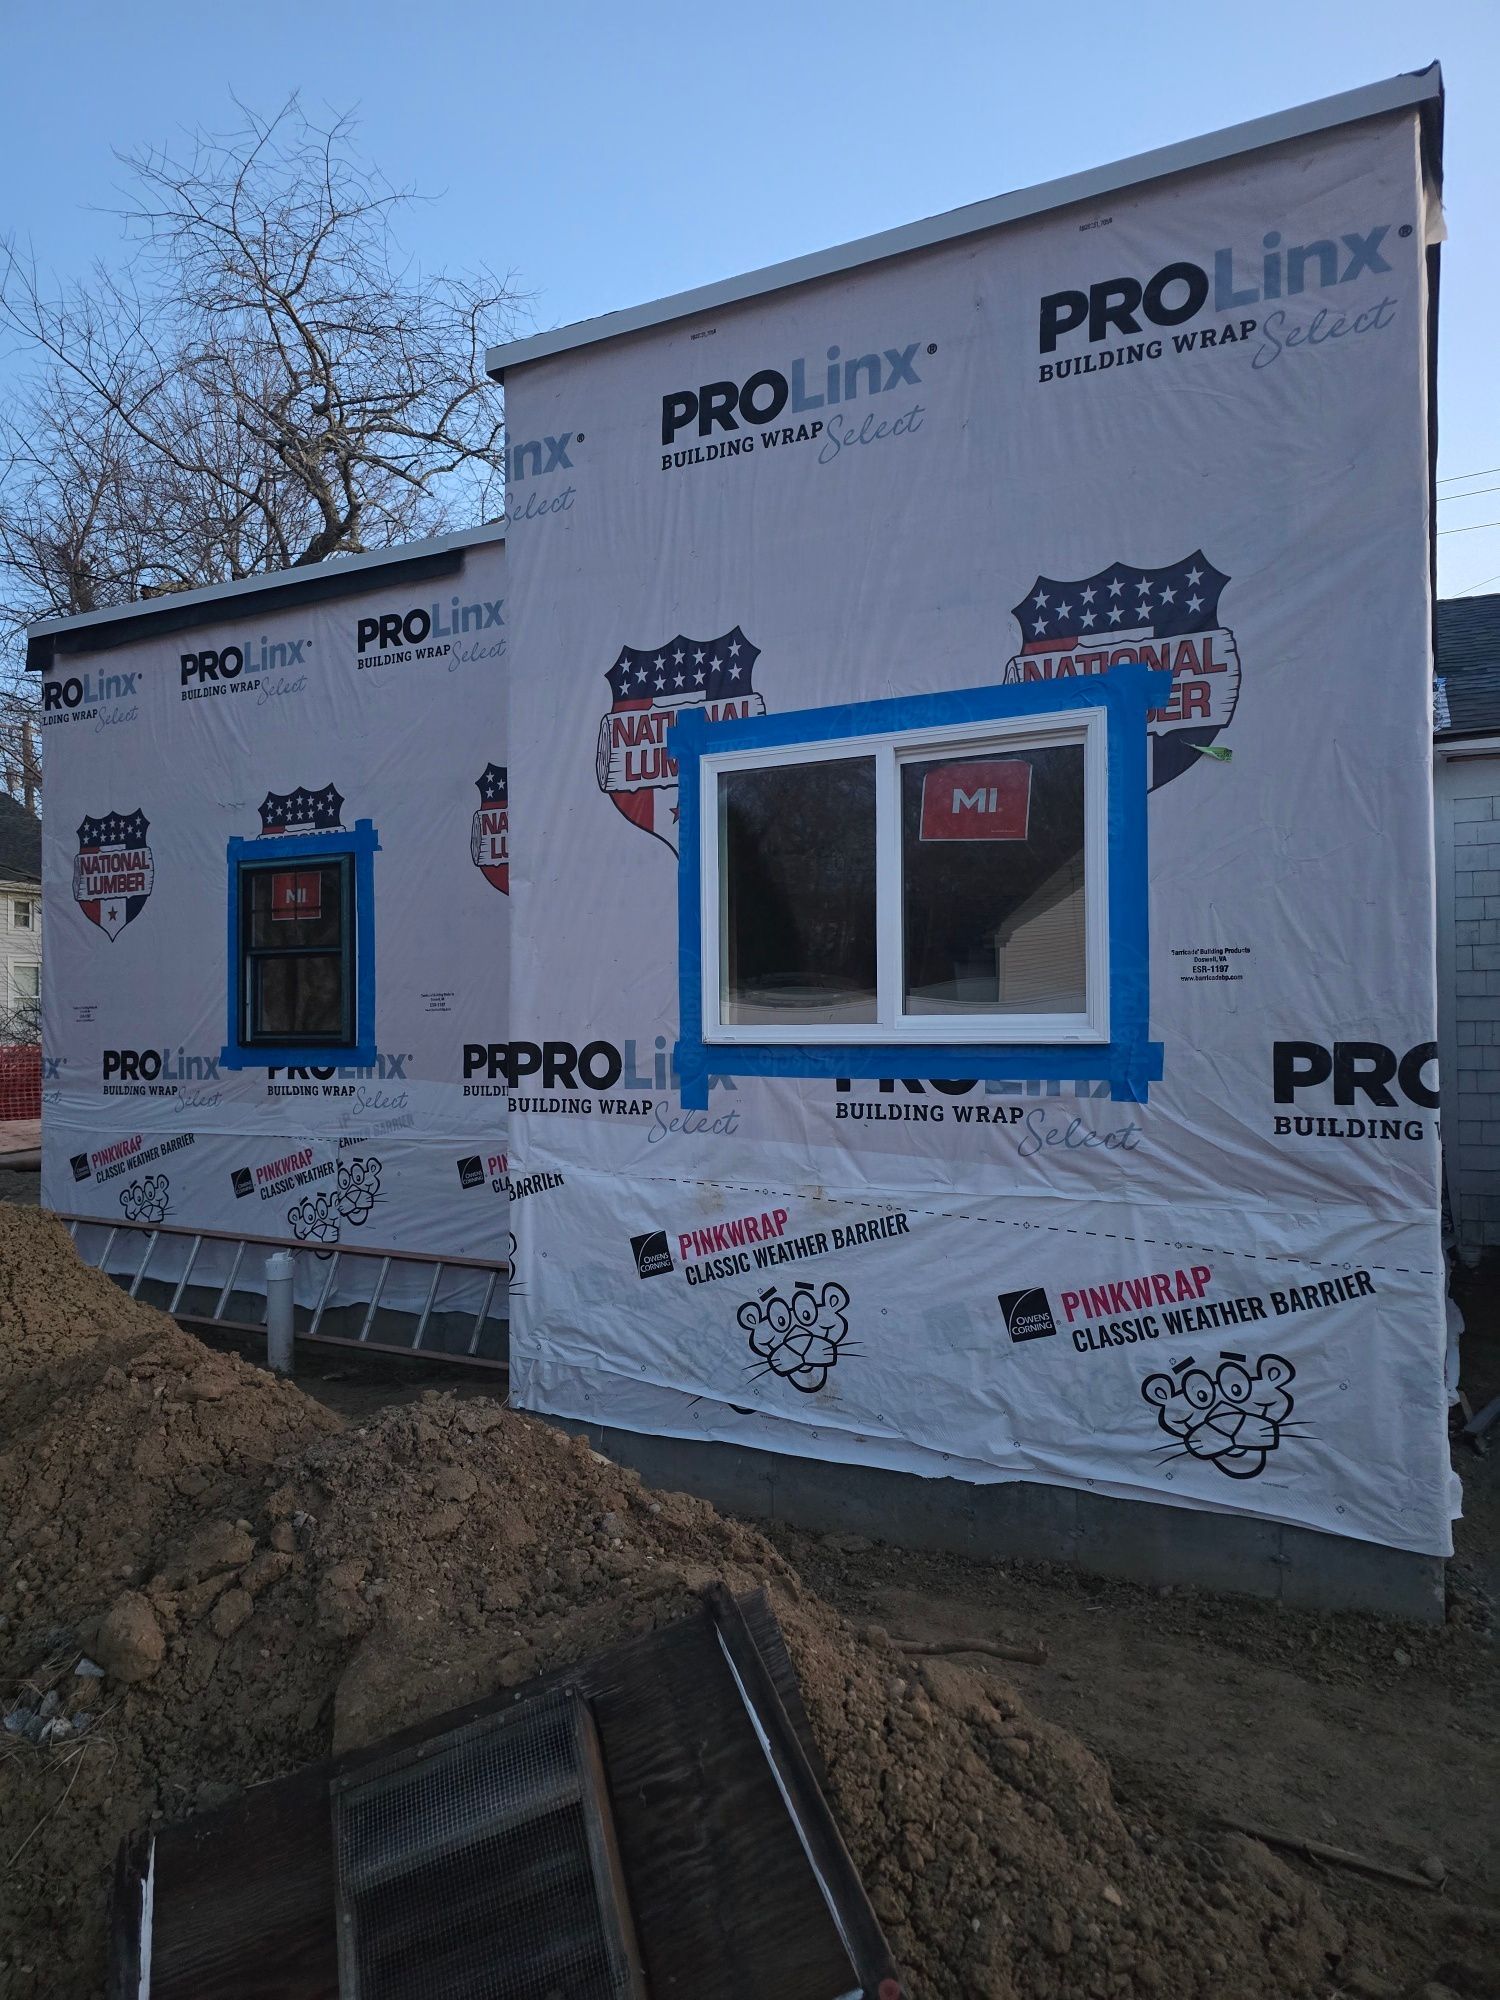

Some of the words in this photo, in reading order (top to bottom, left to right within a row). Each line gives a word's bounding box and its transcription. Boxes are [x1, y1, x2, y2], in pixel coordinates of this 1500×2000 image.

[1039, 224, 1392, 354] PROLinx
[1039, 340, 1163, 383] BUILDING
[1173, 319, 1257, 354] WRAP
[1251, 297, 1397, 370] Select
[662, 342, 922, 446] PROLinx
[661, 436, 754, 471] BUILDING
[761, 421, 824, 448] WRAP
[818, 404, 925, 465] Select
[357, 596, 505, 653] PROLinx
[180, 635, 305, 685] PROLinx
[357, 651, 412, 670] BUILDING
[415, 644, 451, 660] WRAP
[448, 638, 506, 672] Select
[42, 668, 137, 711] ROLinx
[181, 685, 227, 701] BUILDING
[230, 679, 260, 693] WRAP
[257, 675, 307, 705] Select
[72, 709, 98, 722] WRAP
[95, 705, 138, 733] Select
[952, 788, 997, 813] MI
[81, 851, 150, 875] NATIONAL
[87, 873, 145, 895] LUMBER
[1193, 965, 1229, 973] ESR-1197
[103, 1047, 220, 1080] PROLinx
[103, 1085, 146, 1096] BUILDING
[149, 1085, 178, 1096] WRAP
[174, 1086, 222, 1113] Select
[267, 1085, 318, 1096] BUILDING
[322, 1085, 355, 1097] WRAP
[353, 1086, 408, 1114] Select
[463, 1085, 508, 1096] BUILDI
[508, 1098, 592, 1113] BUILDING
[600, 1099, 653, 1115] WRAP
[648, 1101, 740, 1143] Select
[835, 1102, 944, 1123] BUILDING
[952, 1105, 1024, 1124] WRAP
[1017, 1108, 1142, 1157] Select
[1273, 1116, 1423, 1141] BUILDING
[91, 1135, 142, 1169] PINKWRAP
[96, 1162, 125, 1183] CLASSIC
[126, 1147, 160, 1170] WEATHER
[160, 1133, 195, 1156] BARRIER
[256, 1149, 313, 1184] PINKWRAP
[260, 1177, 295, 1200] CLASSIC
[295, 1161, 335, 1187] WEATHER
[678, 1209, 788, 1260] PINKWRAP
[685, 1252, 750, 1286] CLASSIC
[753, 1232, 829, 1269] WEATHER
[831, 1213, 910, 1250] BARRIER
[640, 1261, 671, 1273] CORNING
[643, 1253, 669, 1264] OWENS
[1061, 1265, 1211, 1323] PINKWRAP
[1012, 1321, 1053, 1336] CORNING
[1015, 1312, 1049, 1325] OWENS
[1072, 1315, 1160, 1353] CLASSIC
[1162, 1297, 1267, 1336] WEATHER
[1270, 1270, 1376, 1317] BARRIER
